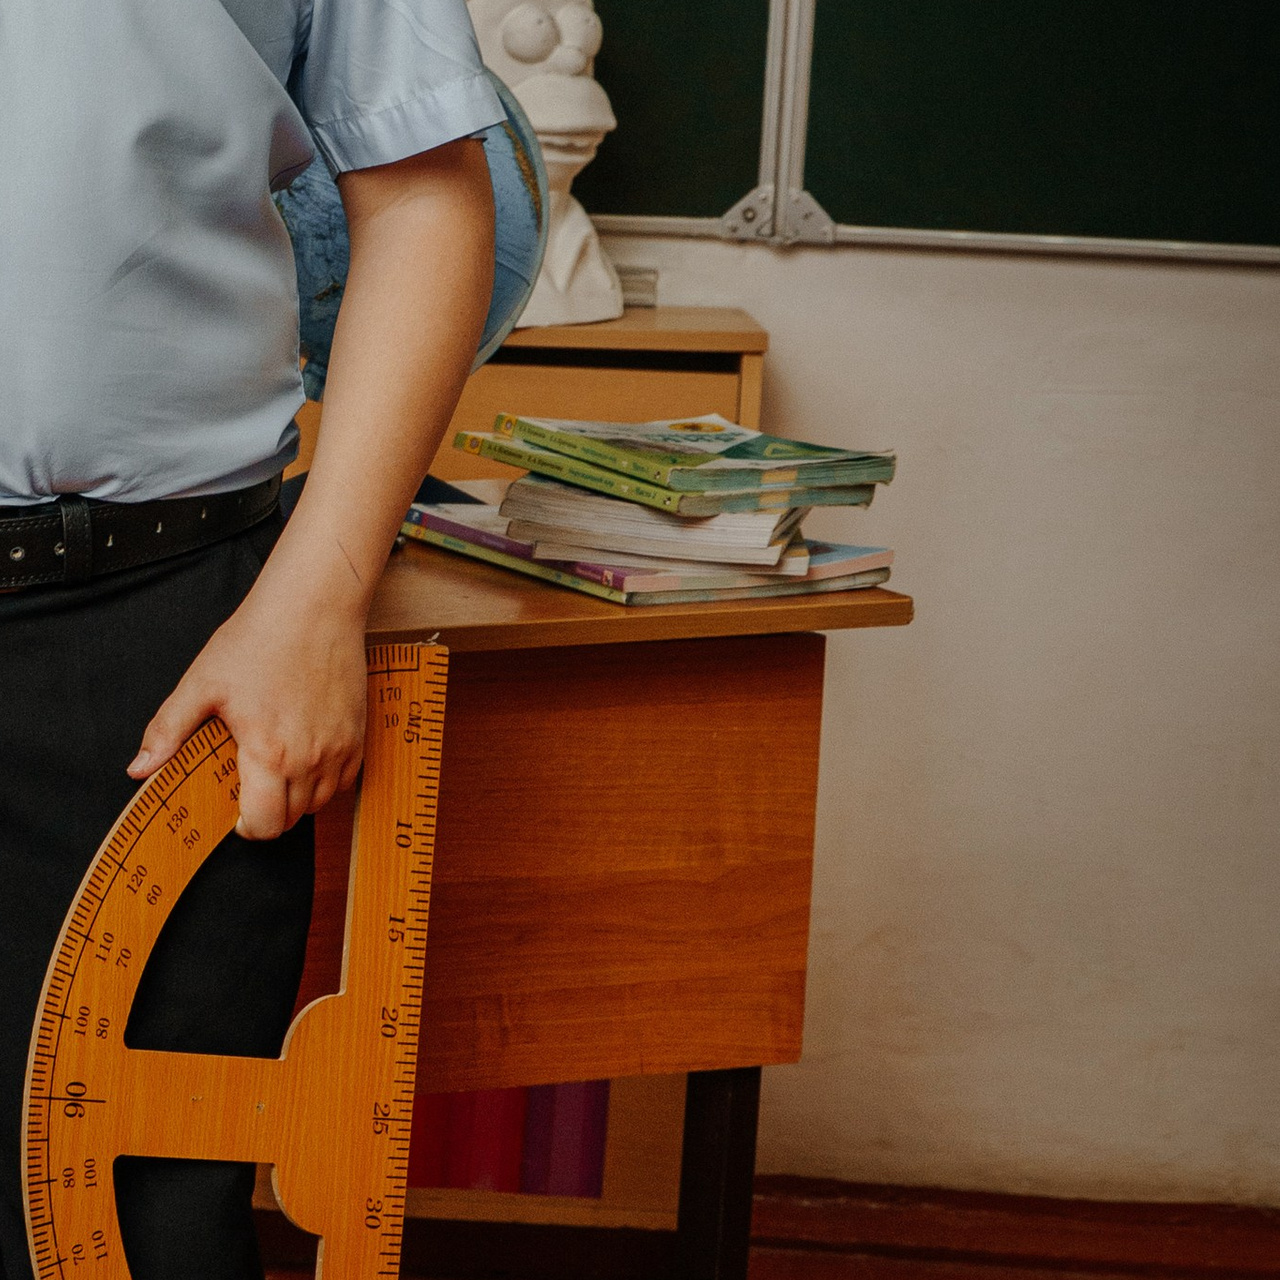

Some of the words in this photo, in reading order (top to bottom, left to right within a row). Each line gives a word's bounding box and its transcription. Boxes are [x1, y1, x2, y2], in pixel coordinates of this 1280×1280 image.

[379, 687, 401, 703] 170
[384, 712, 400, 728] 10
[404, 729, 420, 743] 5
[213, 758, 238, 785] 140
[166, 806, 189, 835] 130
[395, 820, 413, 848] 10
[183, 828, 201, 850] 50
[126, 864, 149, 895] 120
[146, 884, 163, 906] 60
[388, 913, 406, 943] 15
[95, 932, 114, 962] 110
[116, 948, 132, 968] 70
[74, 1006, 91, 1036] 100
[96, 1018, 110, 1039] 80
[381, 1007, 399, 1038] 20
[63, 1082, 87, 1118] 90
[372, 1102, 391, 1135] 25
[62, 1167, 75, 1188] 80
[84, 1158, 98, 1188] 100
[364, 1197, 383, 1230] 30
[72, 1243, 86, 1266] 70
[91, 1230, 108, 1261] 110
